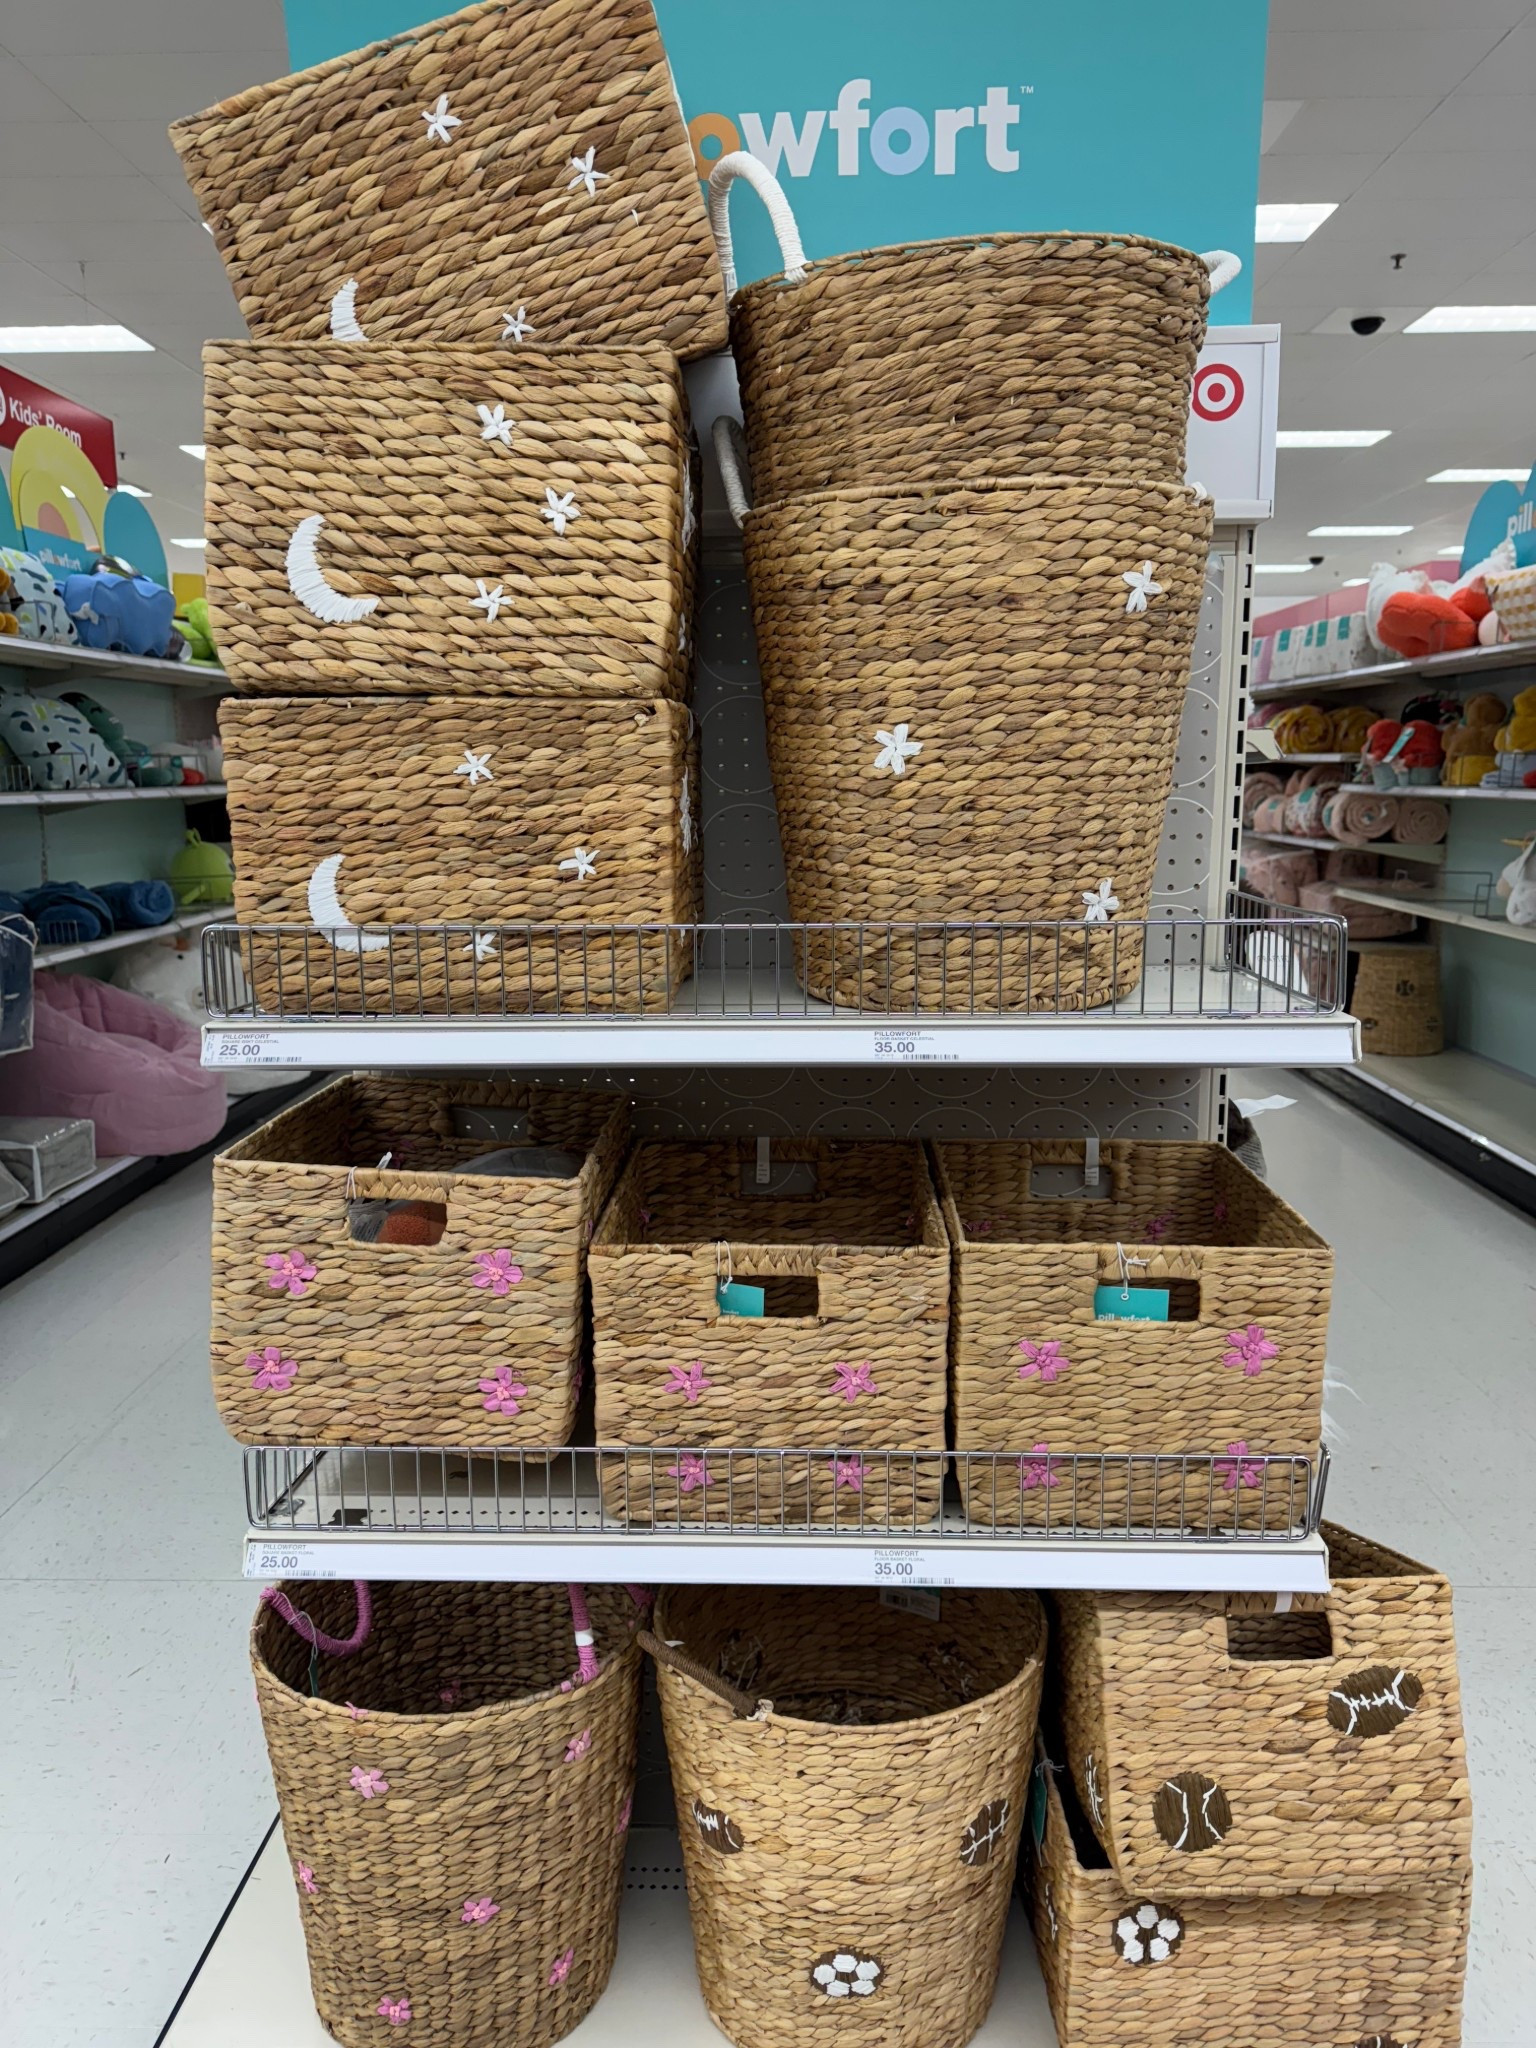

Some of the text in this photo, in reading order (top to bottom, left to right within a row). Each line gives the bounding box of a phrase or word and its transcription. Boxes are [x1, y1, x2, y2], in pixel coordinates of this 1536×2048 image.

[219, 1044, 260, 1056] 25.00
[874, 1041, 915, 1053] 35.00
[260, 1555, 298, 1568] 25.00
[874, 1562, 913, 1575] 35.00
